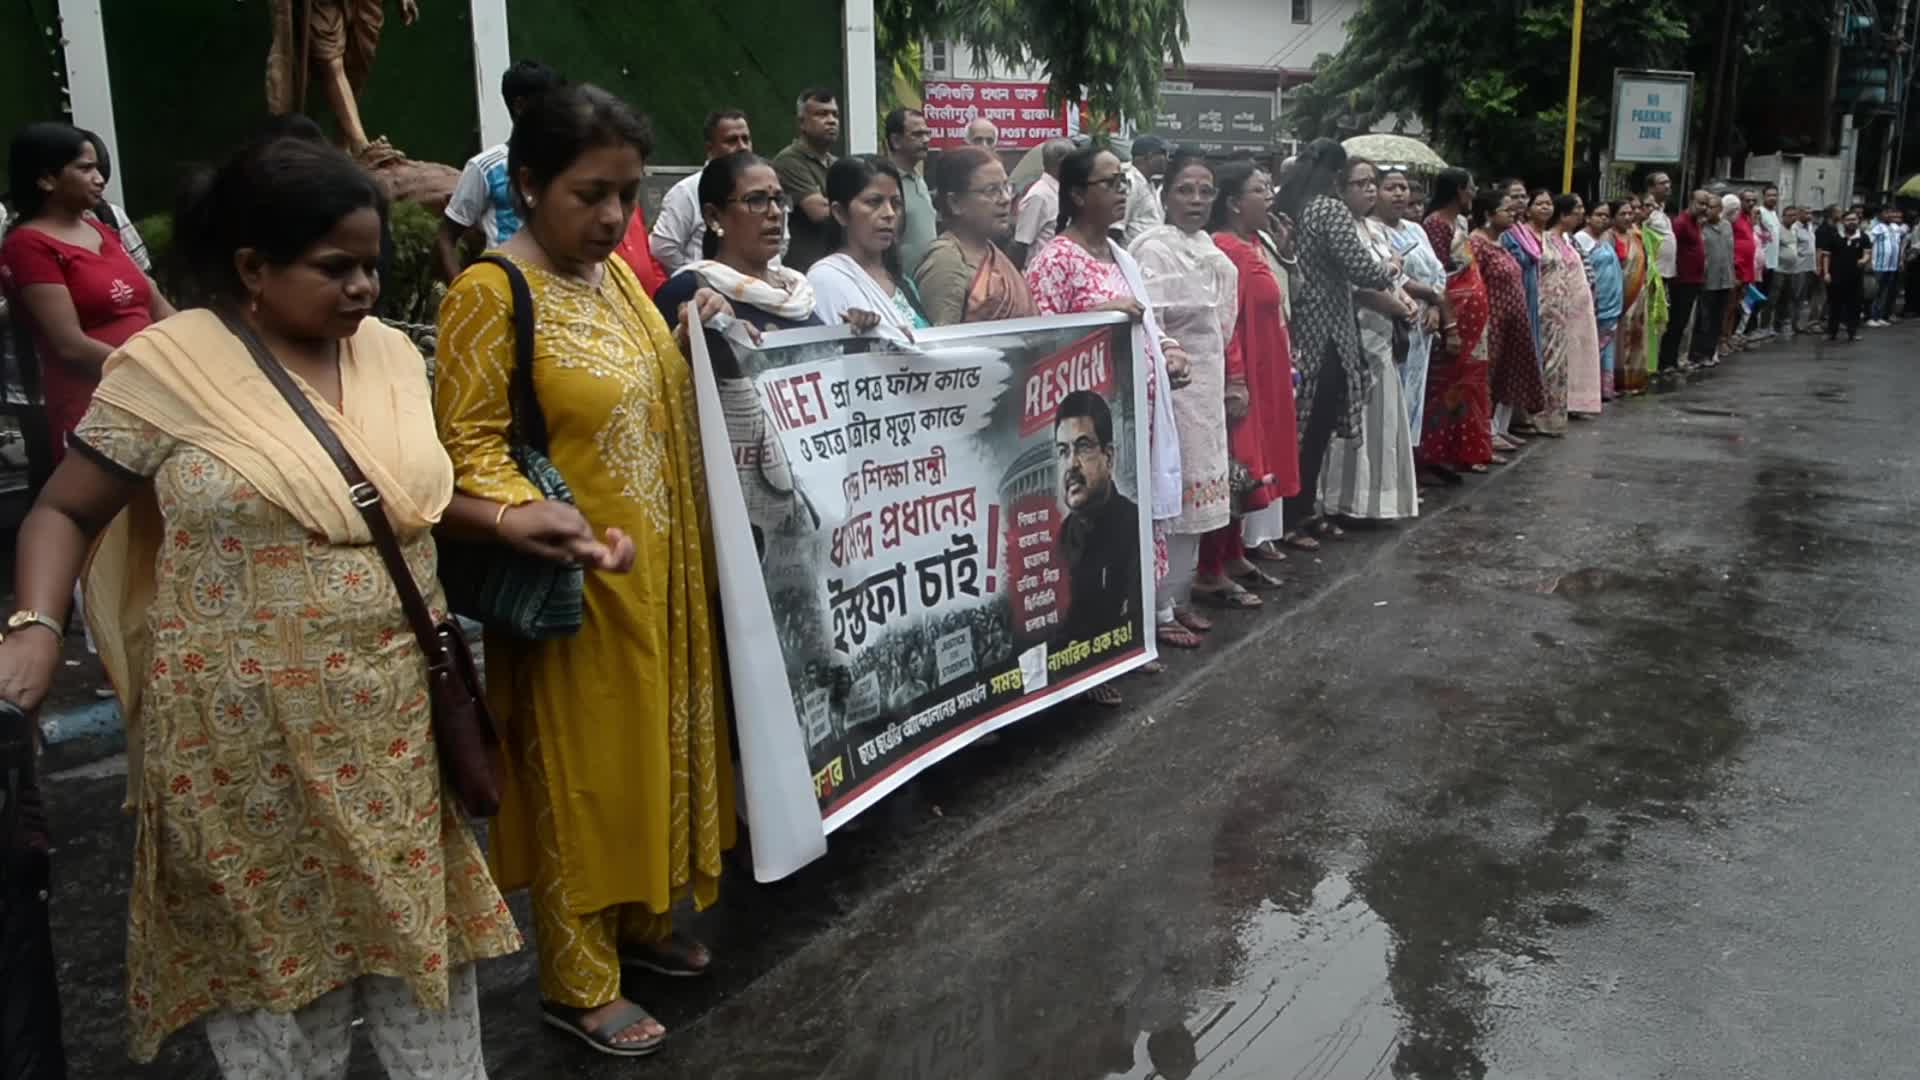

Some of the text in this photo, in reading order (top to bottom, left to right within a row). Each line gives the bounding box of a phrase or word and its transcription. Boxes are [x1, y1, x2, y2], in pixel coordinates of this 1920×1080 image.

[1001, 128, 1026, 138] POST
[1029, 128, 1063, 138] OFFICE
[1631, 108, 1672, 122] PARKING
[1639, 126, 1662, 140] ZONE
[764, 371, 829, 431] NEET
[885, 366, 930, 396] ফাঁস
[1025, 341, 1106, 417] RESIGN
[862, 458, 909, 495] শিক্ষা
[913, 445, 948, 486] মন্ত্রী
[879, 486, 977, 550] প্রধানের
[827, 562, 908, 654] ইস্তফা
[1047, 639, 1092, 672] নাগরিক
[1092, 632, 1113, 654] এক
